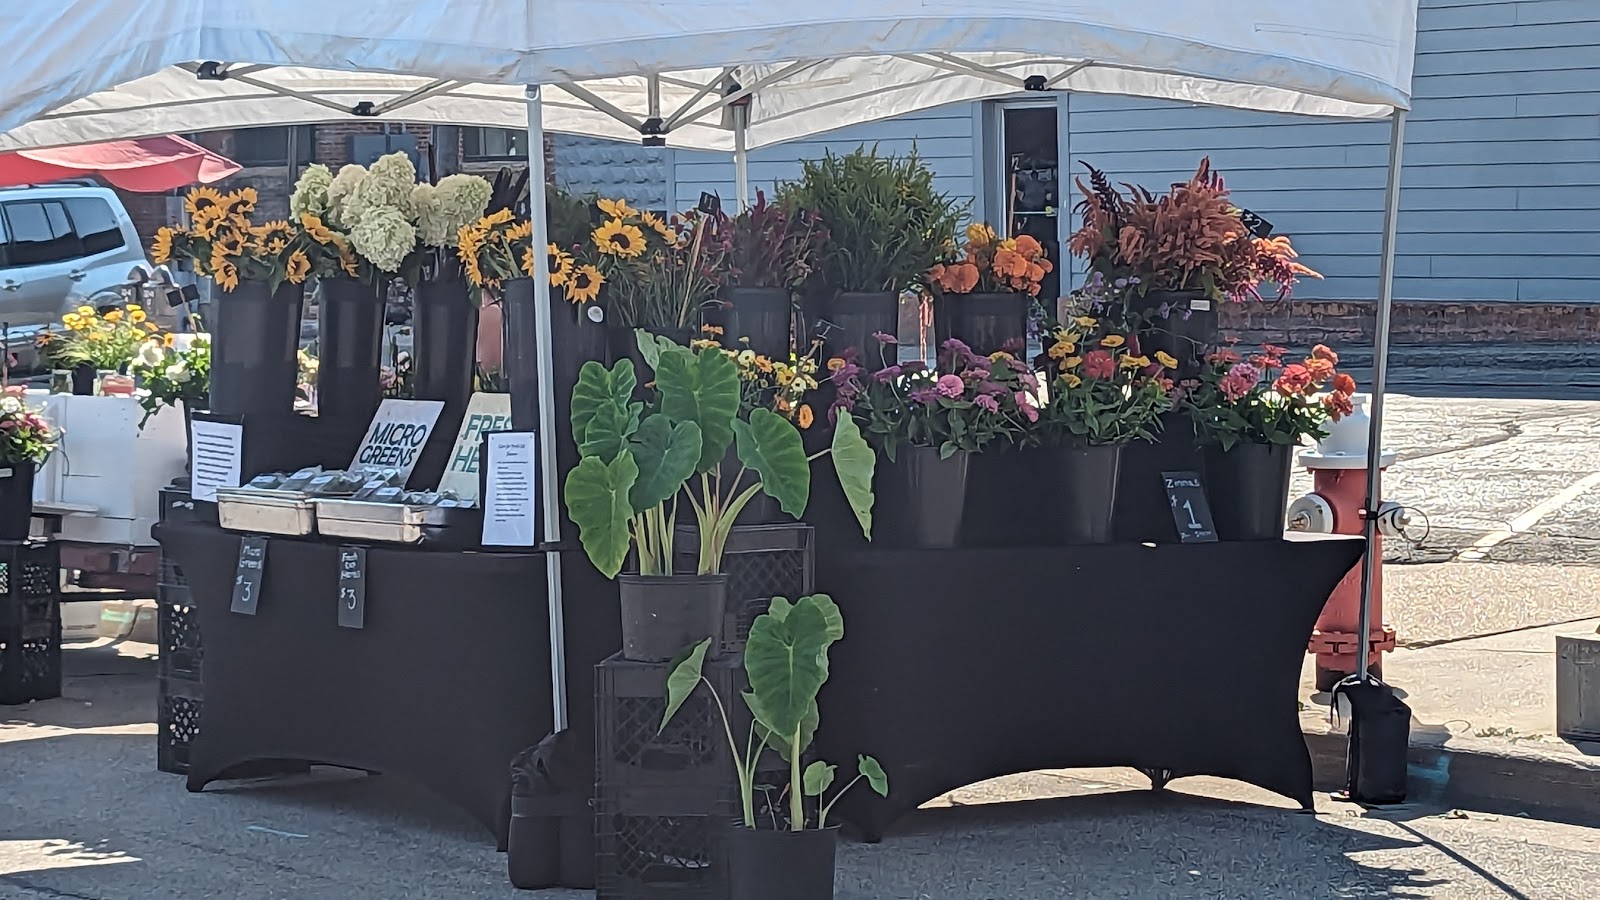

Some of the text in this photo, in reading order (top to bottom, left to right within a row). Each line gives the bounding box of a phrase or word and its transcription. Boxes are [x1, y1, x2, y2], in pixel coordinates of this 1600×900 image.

[368, 422, 427, 447] MICRO
[463, 414, 511, 441] FRE
[359, 445, 417, 467] GREENS
